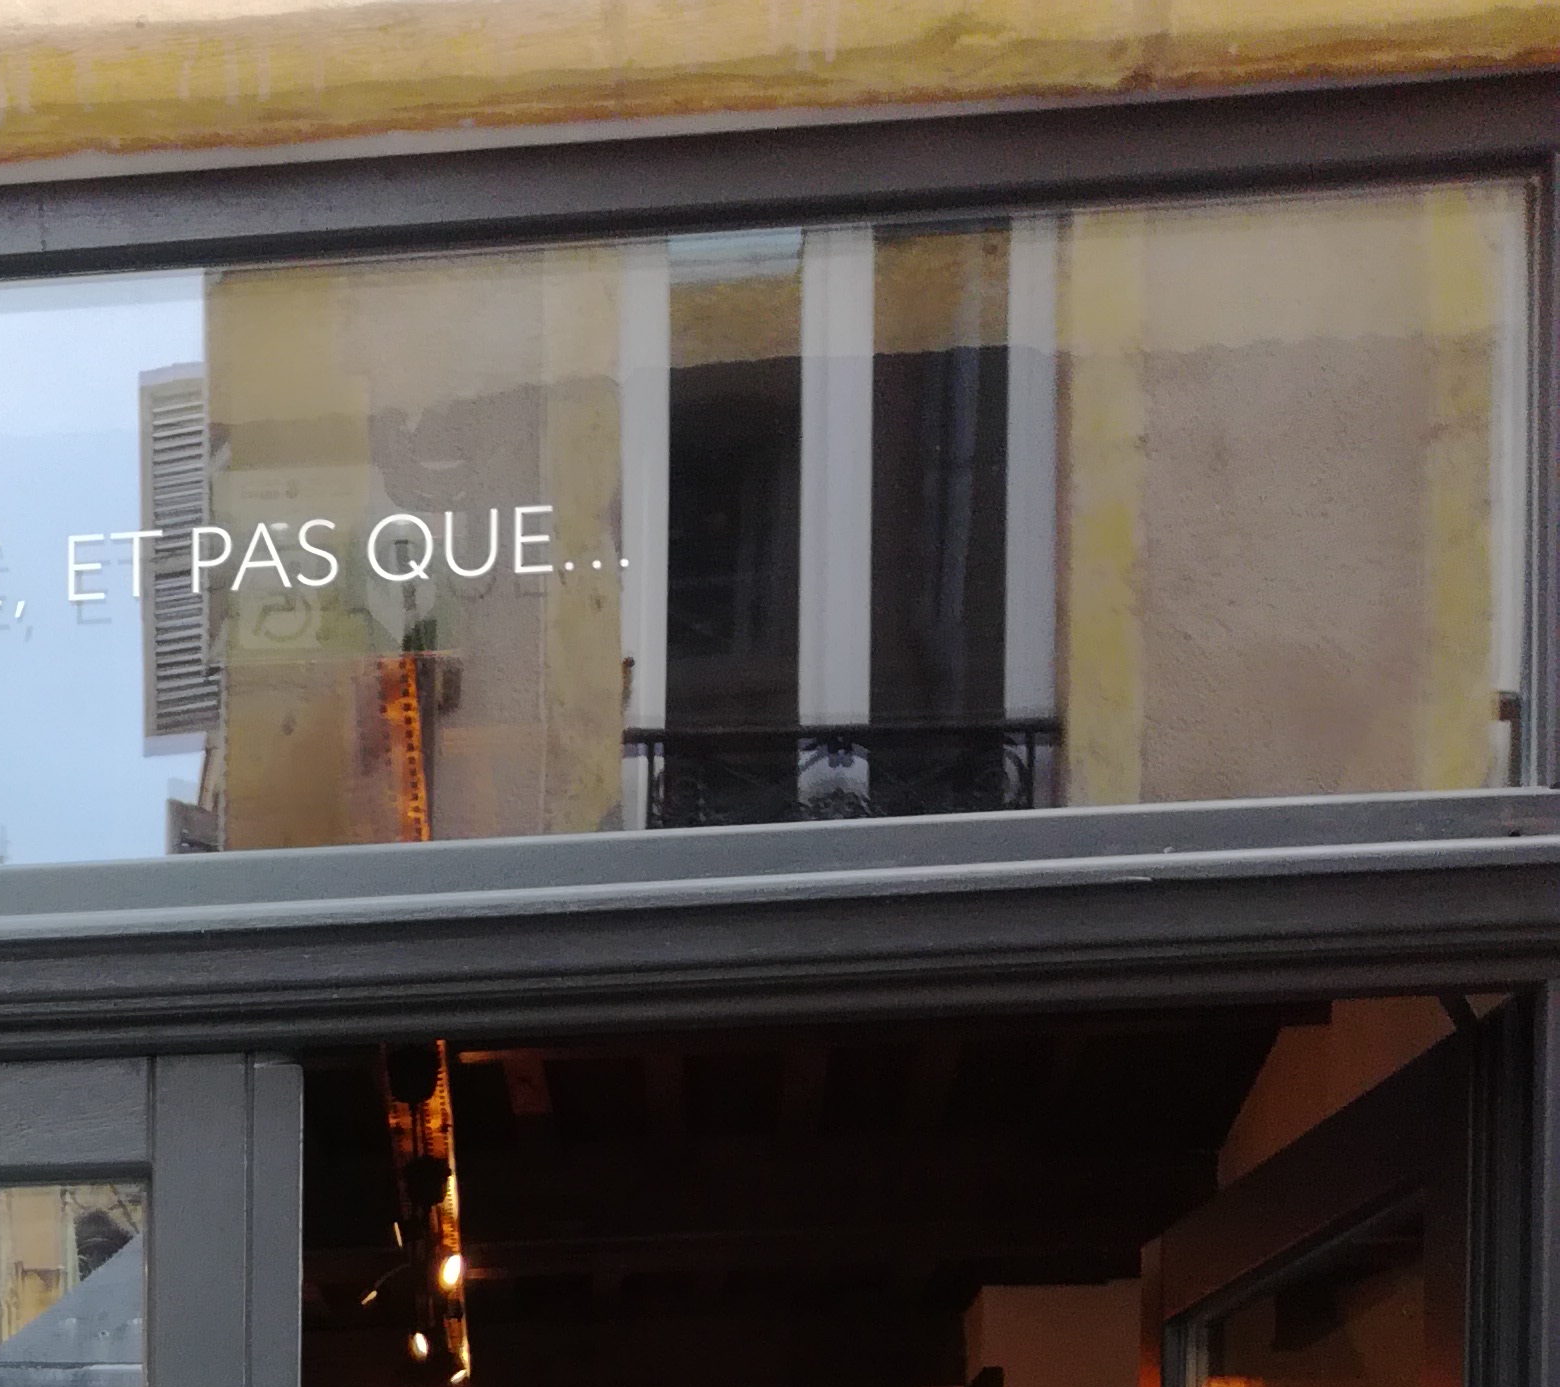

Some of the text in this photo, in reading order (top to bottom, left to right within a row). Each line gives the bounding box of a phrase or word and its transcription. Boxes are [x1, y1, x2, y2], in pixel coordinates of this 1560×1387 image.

[66, 529, 164, 602] ET
[190, 518, 340, 594] PAS
[366, 505, 630, 582] QUE...
